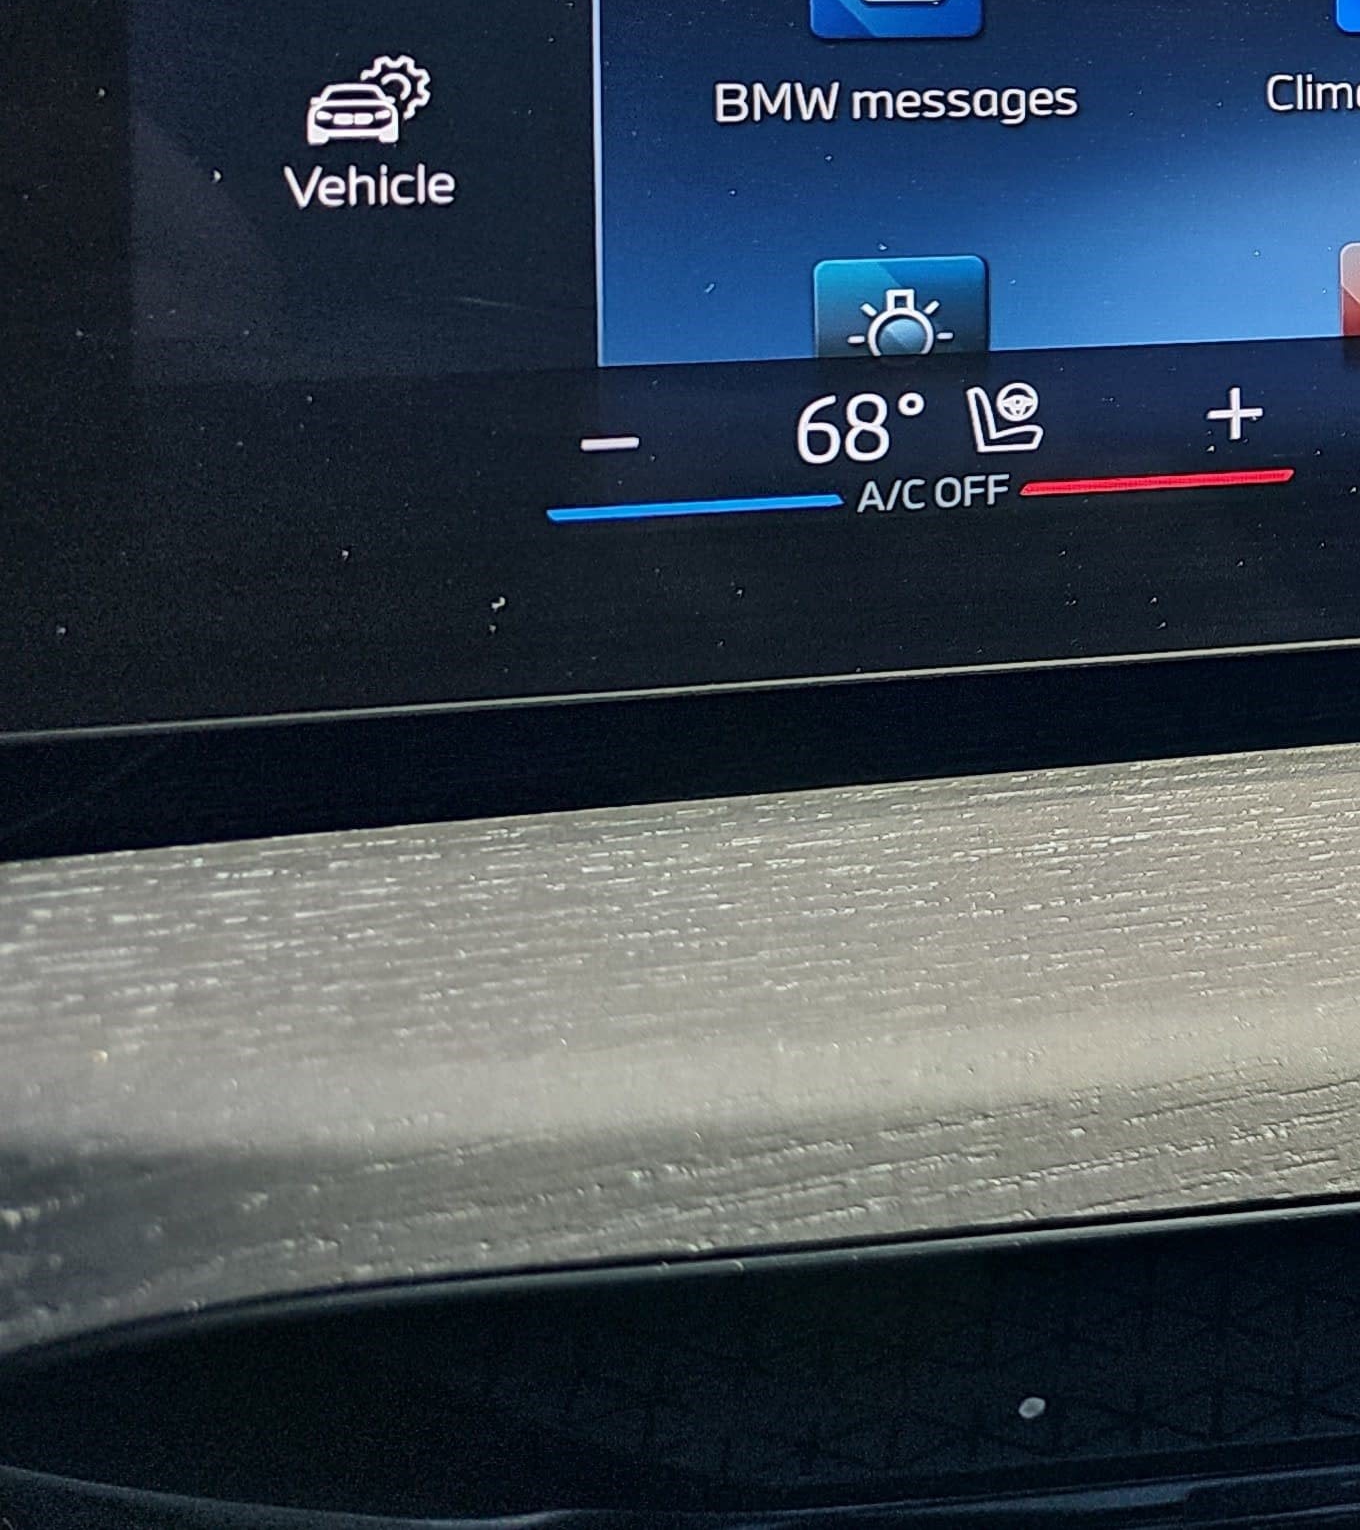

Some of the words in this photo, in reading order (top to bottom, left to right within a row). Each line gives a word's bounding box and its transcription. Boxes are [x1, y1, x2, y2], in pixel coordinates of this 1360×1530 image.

[715, 80, 840, 123] BMW
[851, 85, 1079, 130] messages
[283, 162, 457, 209] Vehicle
[856, 477, 926, 514] A/C
[934, 472, 1011, 509] OFF
